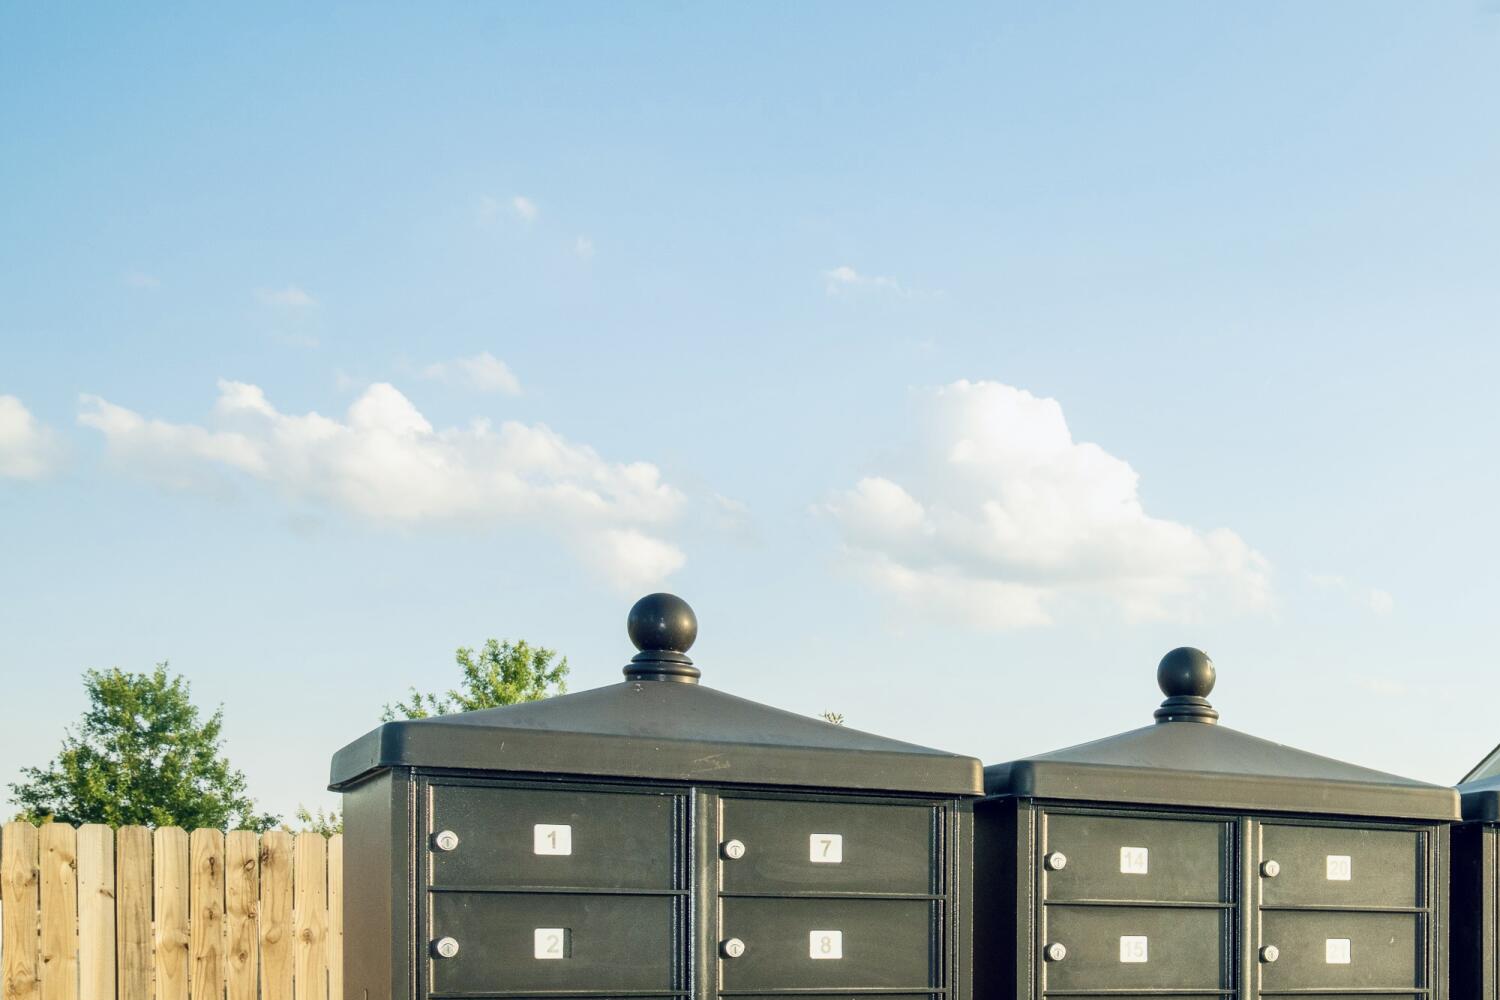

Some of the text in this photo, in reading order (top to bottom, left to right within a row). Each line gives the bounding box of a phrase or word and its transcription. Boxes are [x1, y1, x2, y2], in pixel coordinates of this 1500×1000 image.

[547, 831, 557, 849] 1
[820, 840, 832, 858] 7
[1125, 852, 1145, 868] 14
[1330, 861, 1349, 877] 20
[547, 935, 559, 954] 2
[821, 936, 832, 954] 8
[1127, 941, 1144, 958] 15
